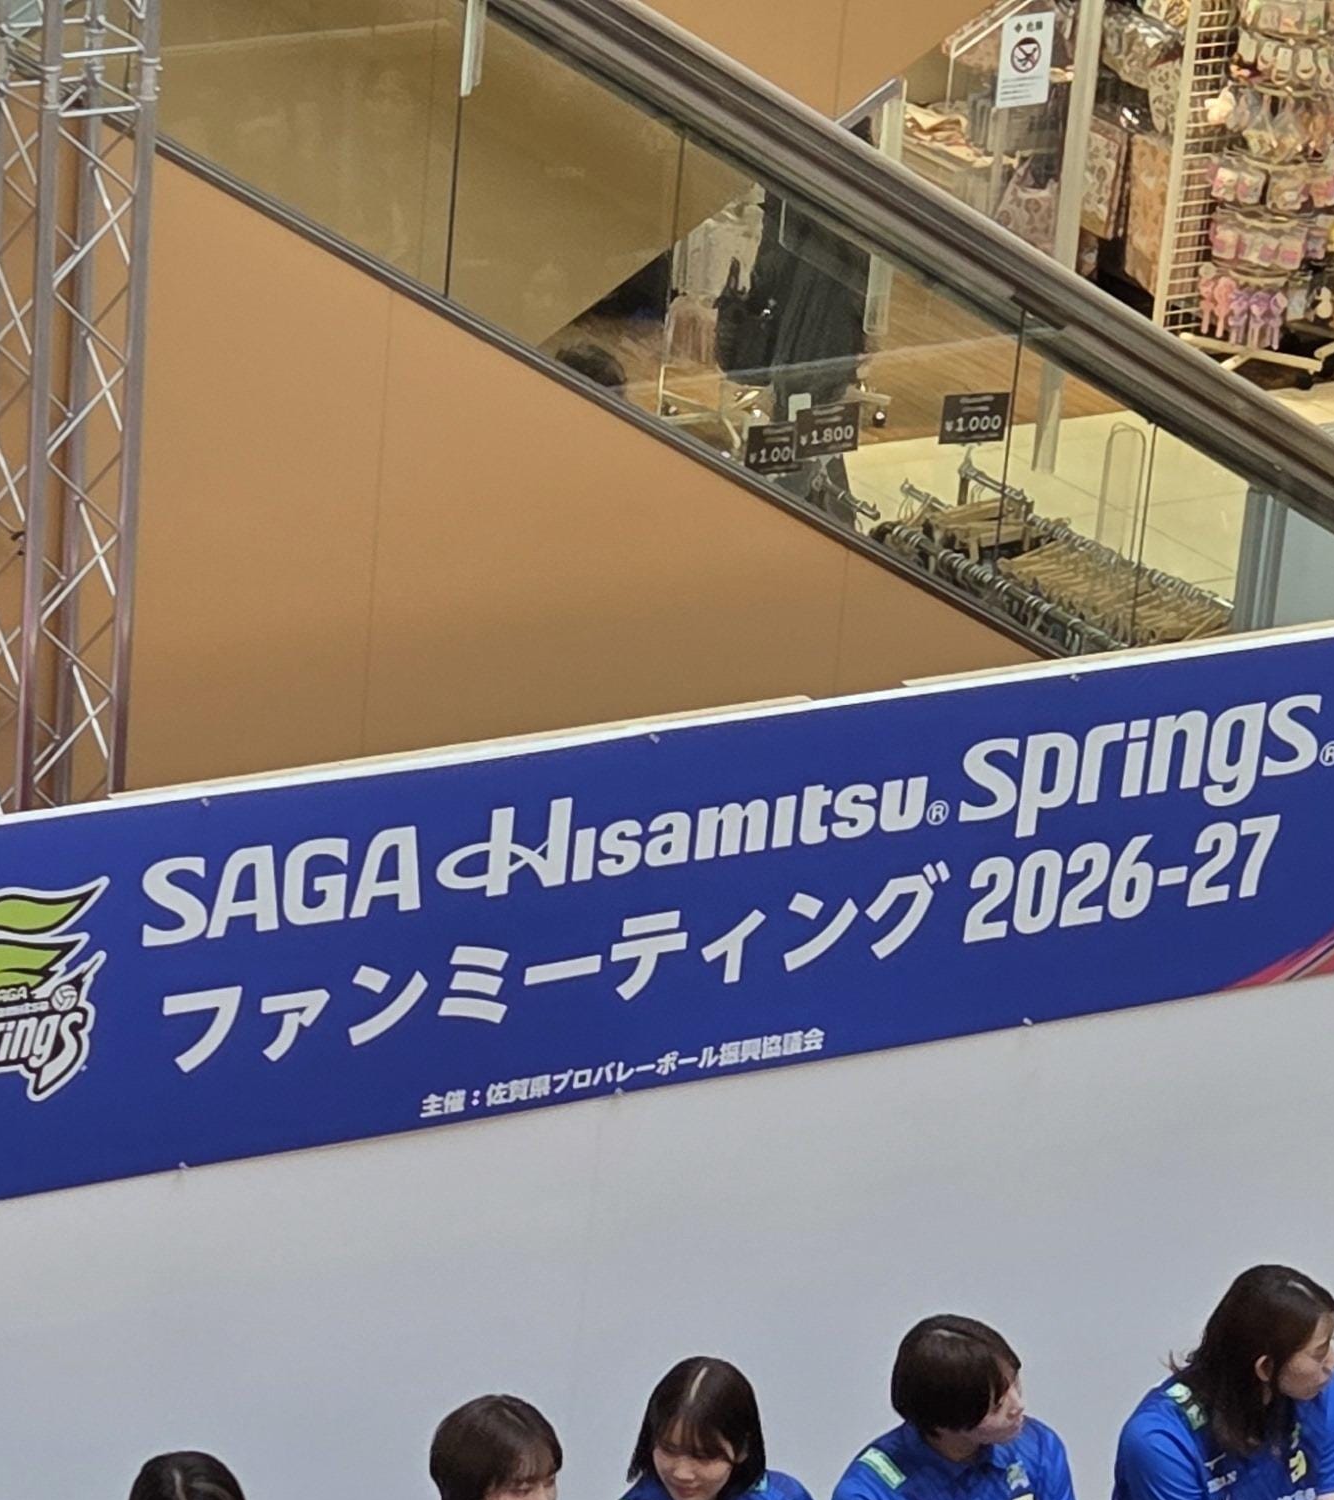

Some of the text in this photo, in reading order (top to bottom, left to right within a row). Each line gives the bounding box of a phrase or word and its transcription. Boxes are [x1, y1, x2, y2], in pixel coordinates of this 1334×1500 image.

[141, 825, 421, 948] SAGA
[161, 814, 1282, 1074] ファンミーティング 2026-27
